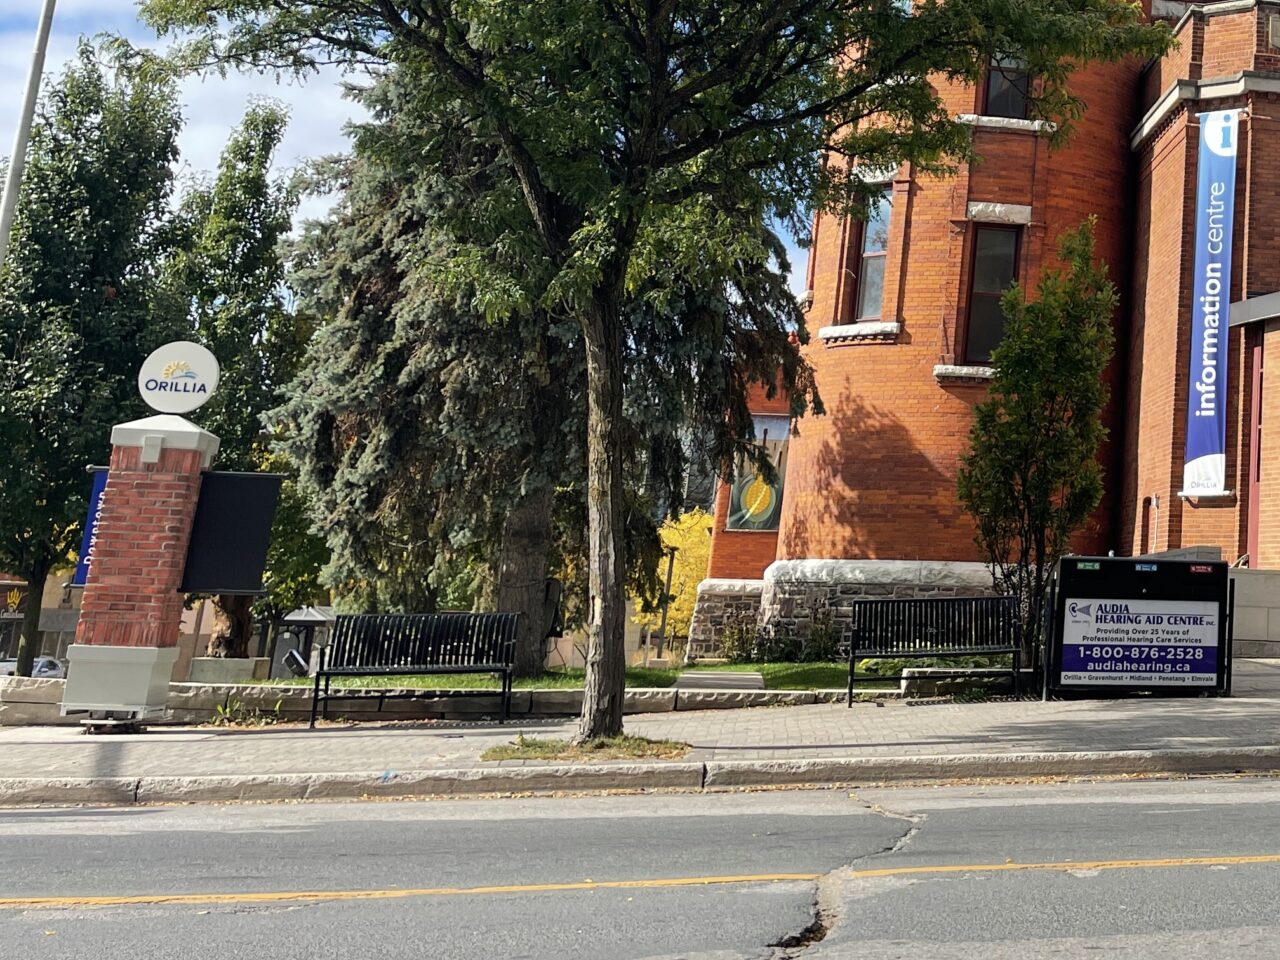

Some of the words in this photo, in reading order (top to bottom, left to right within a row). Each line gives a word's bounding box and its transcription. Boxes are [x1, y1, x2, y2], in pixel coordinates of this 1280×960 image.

[1205, 183, 1225, 254] centre
[1195, 264, 1223, 416] information
[145, 379, 206, 394] ORILLIA
[84, 492, 105, 564] Downtown
[1096, 604, 1130, 614] AUDIA
[1095, 615, 1141, 625] HEARING
[1145, 616, 1164, 625] AID
[1168, 616, 1205, 626] CENTRE
[1078, 646, 1204, 659] 1-800-876-2528
[1087, 661, 1190, 673] audiahearing.ca
